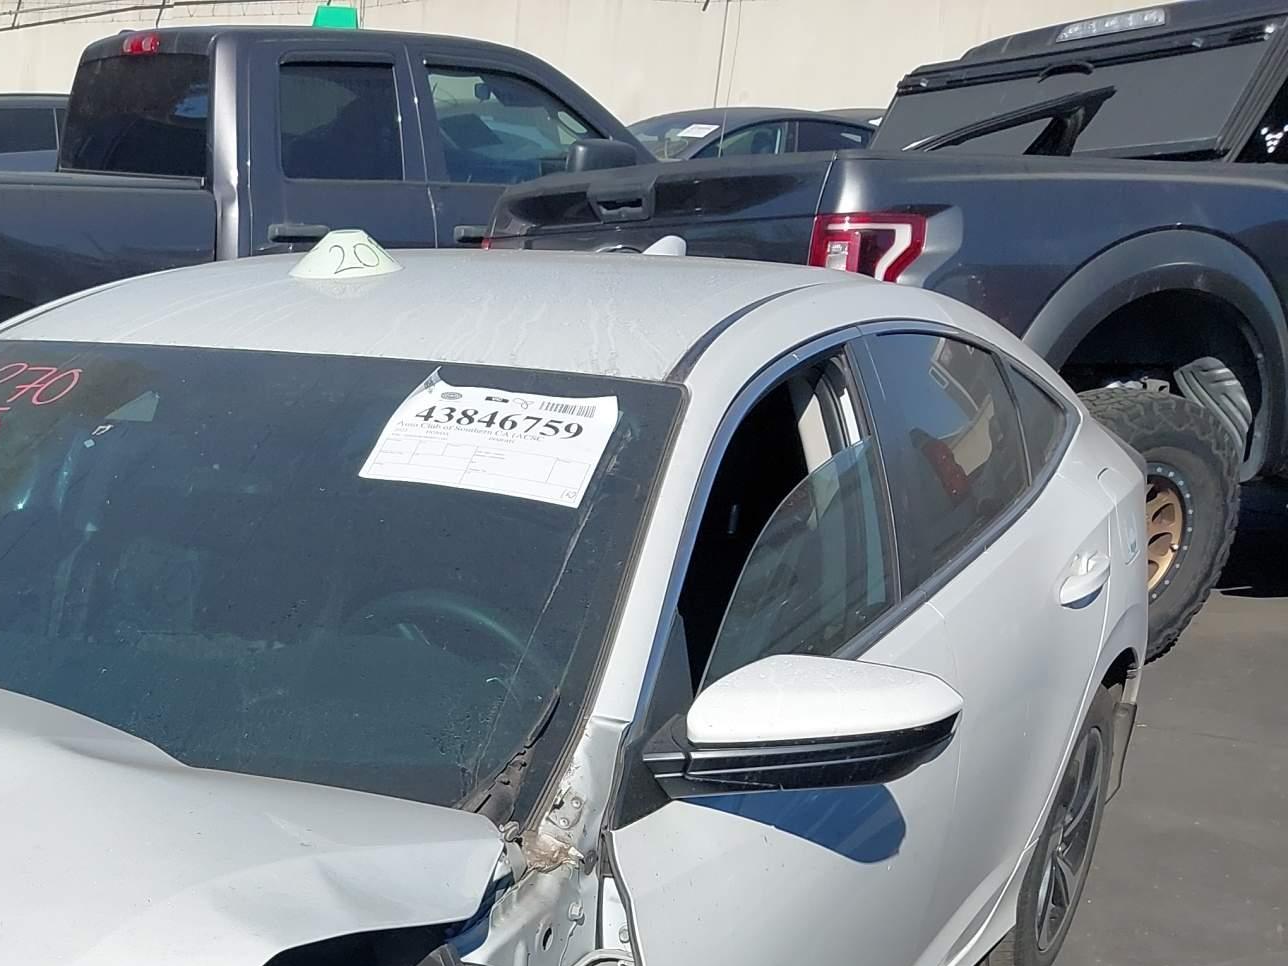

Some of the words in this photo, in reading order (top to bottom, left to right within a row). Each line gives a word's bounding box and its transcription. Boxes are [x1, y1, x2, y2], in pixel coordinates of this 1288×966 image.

[329, 243, 380, 275] 20
[414, 404, 584, 440] 43846759
[454, 425, 493, 436] Southern
